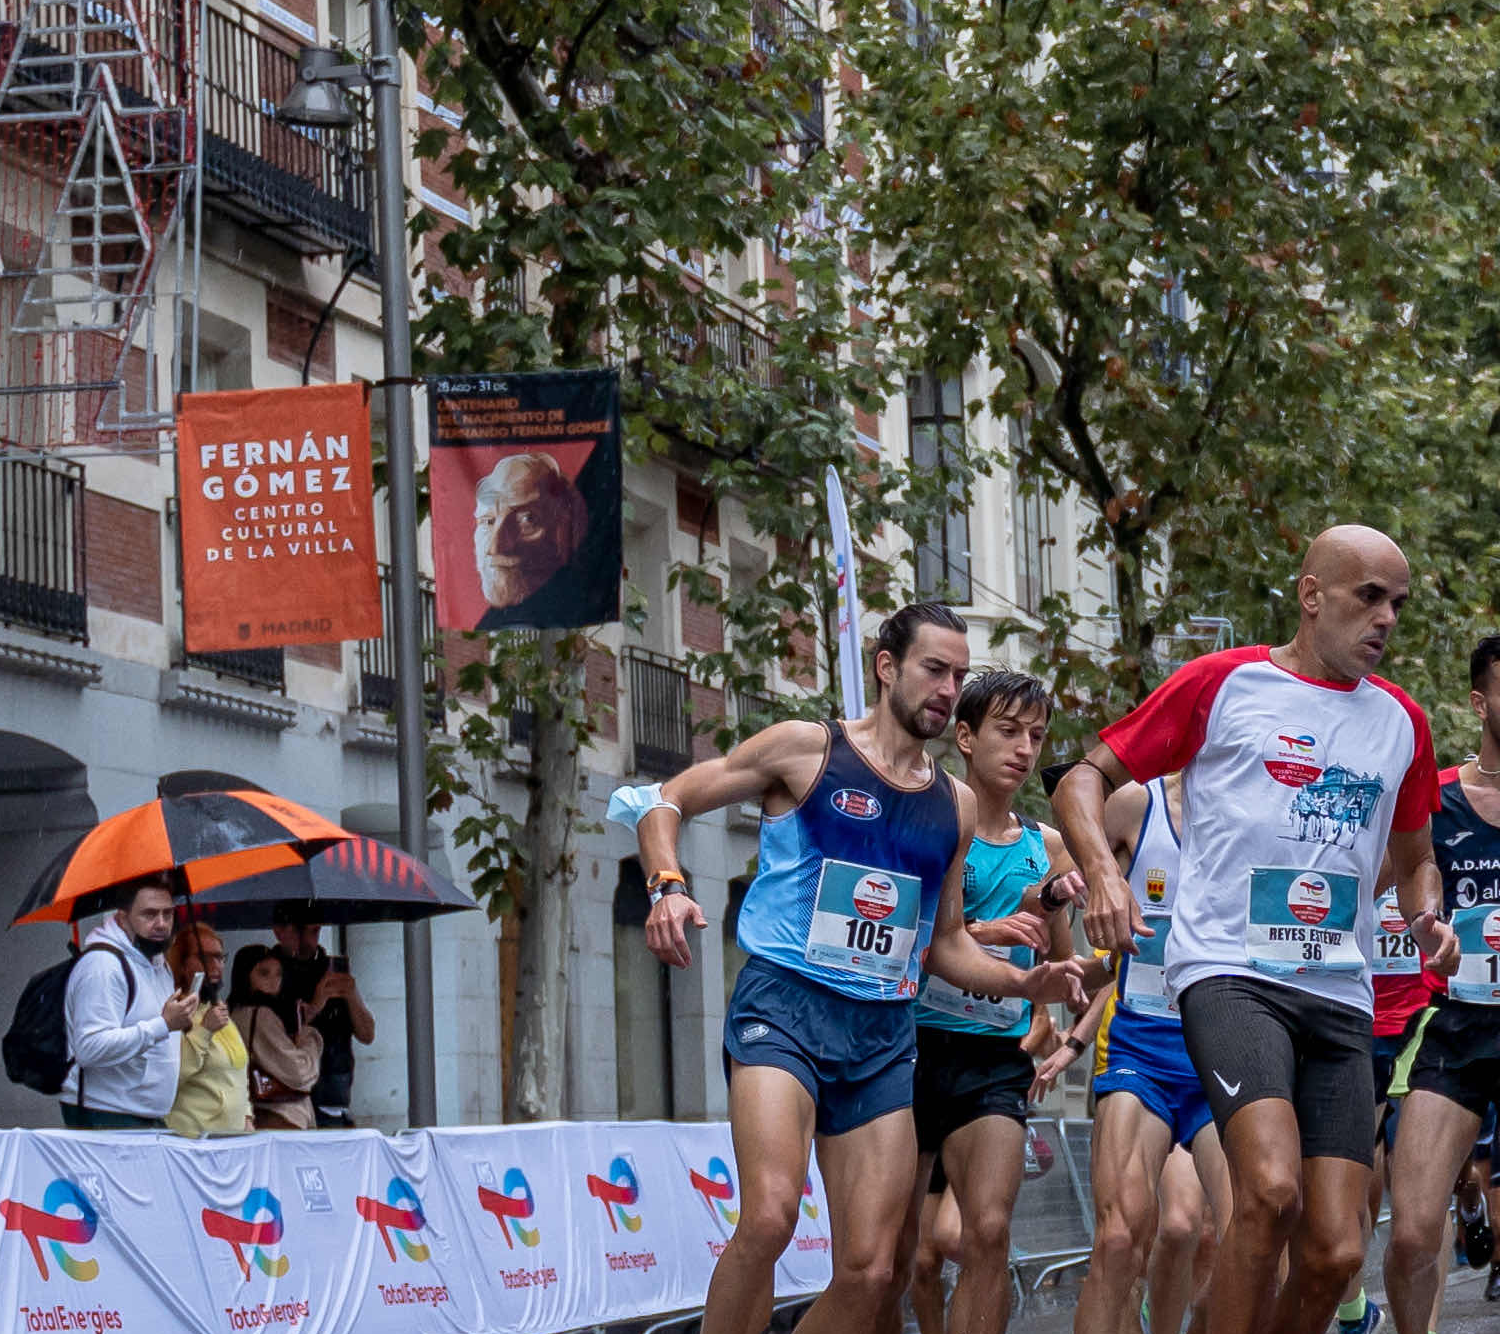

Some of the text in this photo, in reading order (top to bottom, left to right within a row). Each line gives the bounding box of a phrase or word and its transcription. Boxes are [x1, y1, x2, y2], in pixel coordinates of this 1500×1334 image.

[201, 431, 349, 468] FERNÁN
[202, 467, 351, 500] GÓMEZ
[234, 502, 324, 521] CENTRO
[221, 520, 338, 542] CULTURAL
[206, 538, 354, 562] DE LA VILLA
[261, 619, 332, 636] MADRID
[846, 919, 894, 956] 105
[1269, 927, 1306, 941] REYES
[1302, 943, 1322, 961] 36
[1377, 934, 1416, 958] 128
